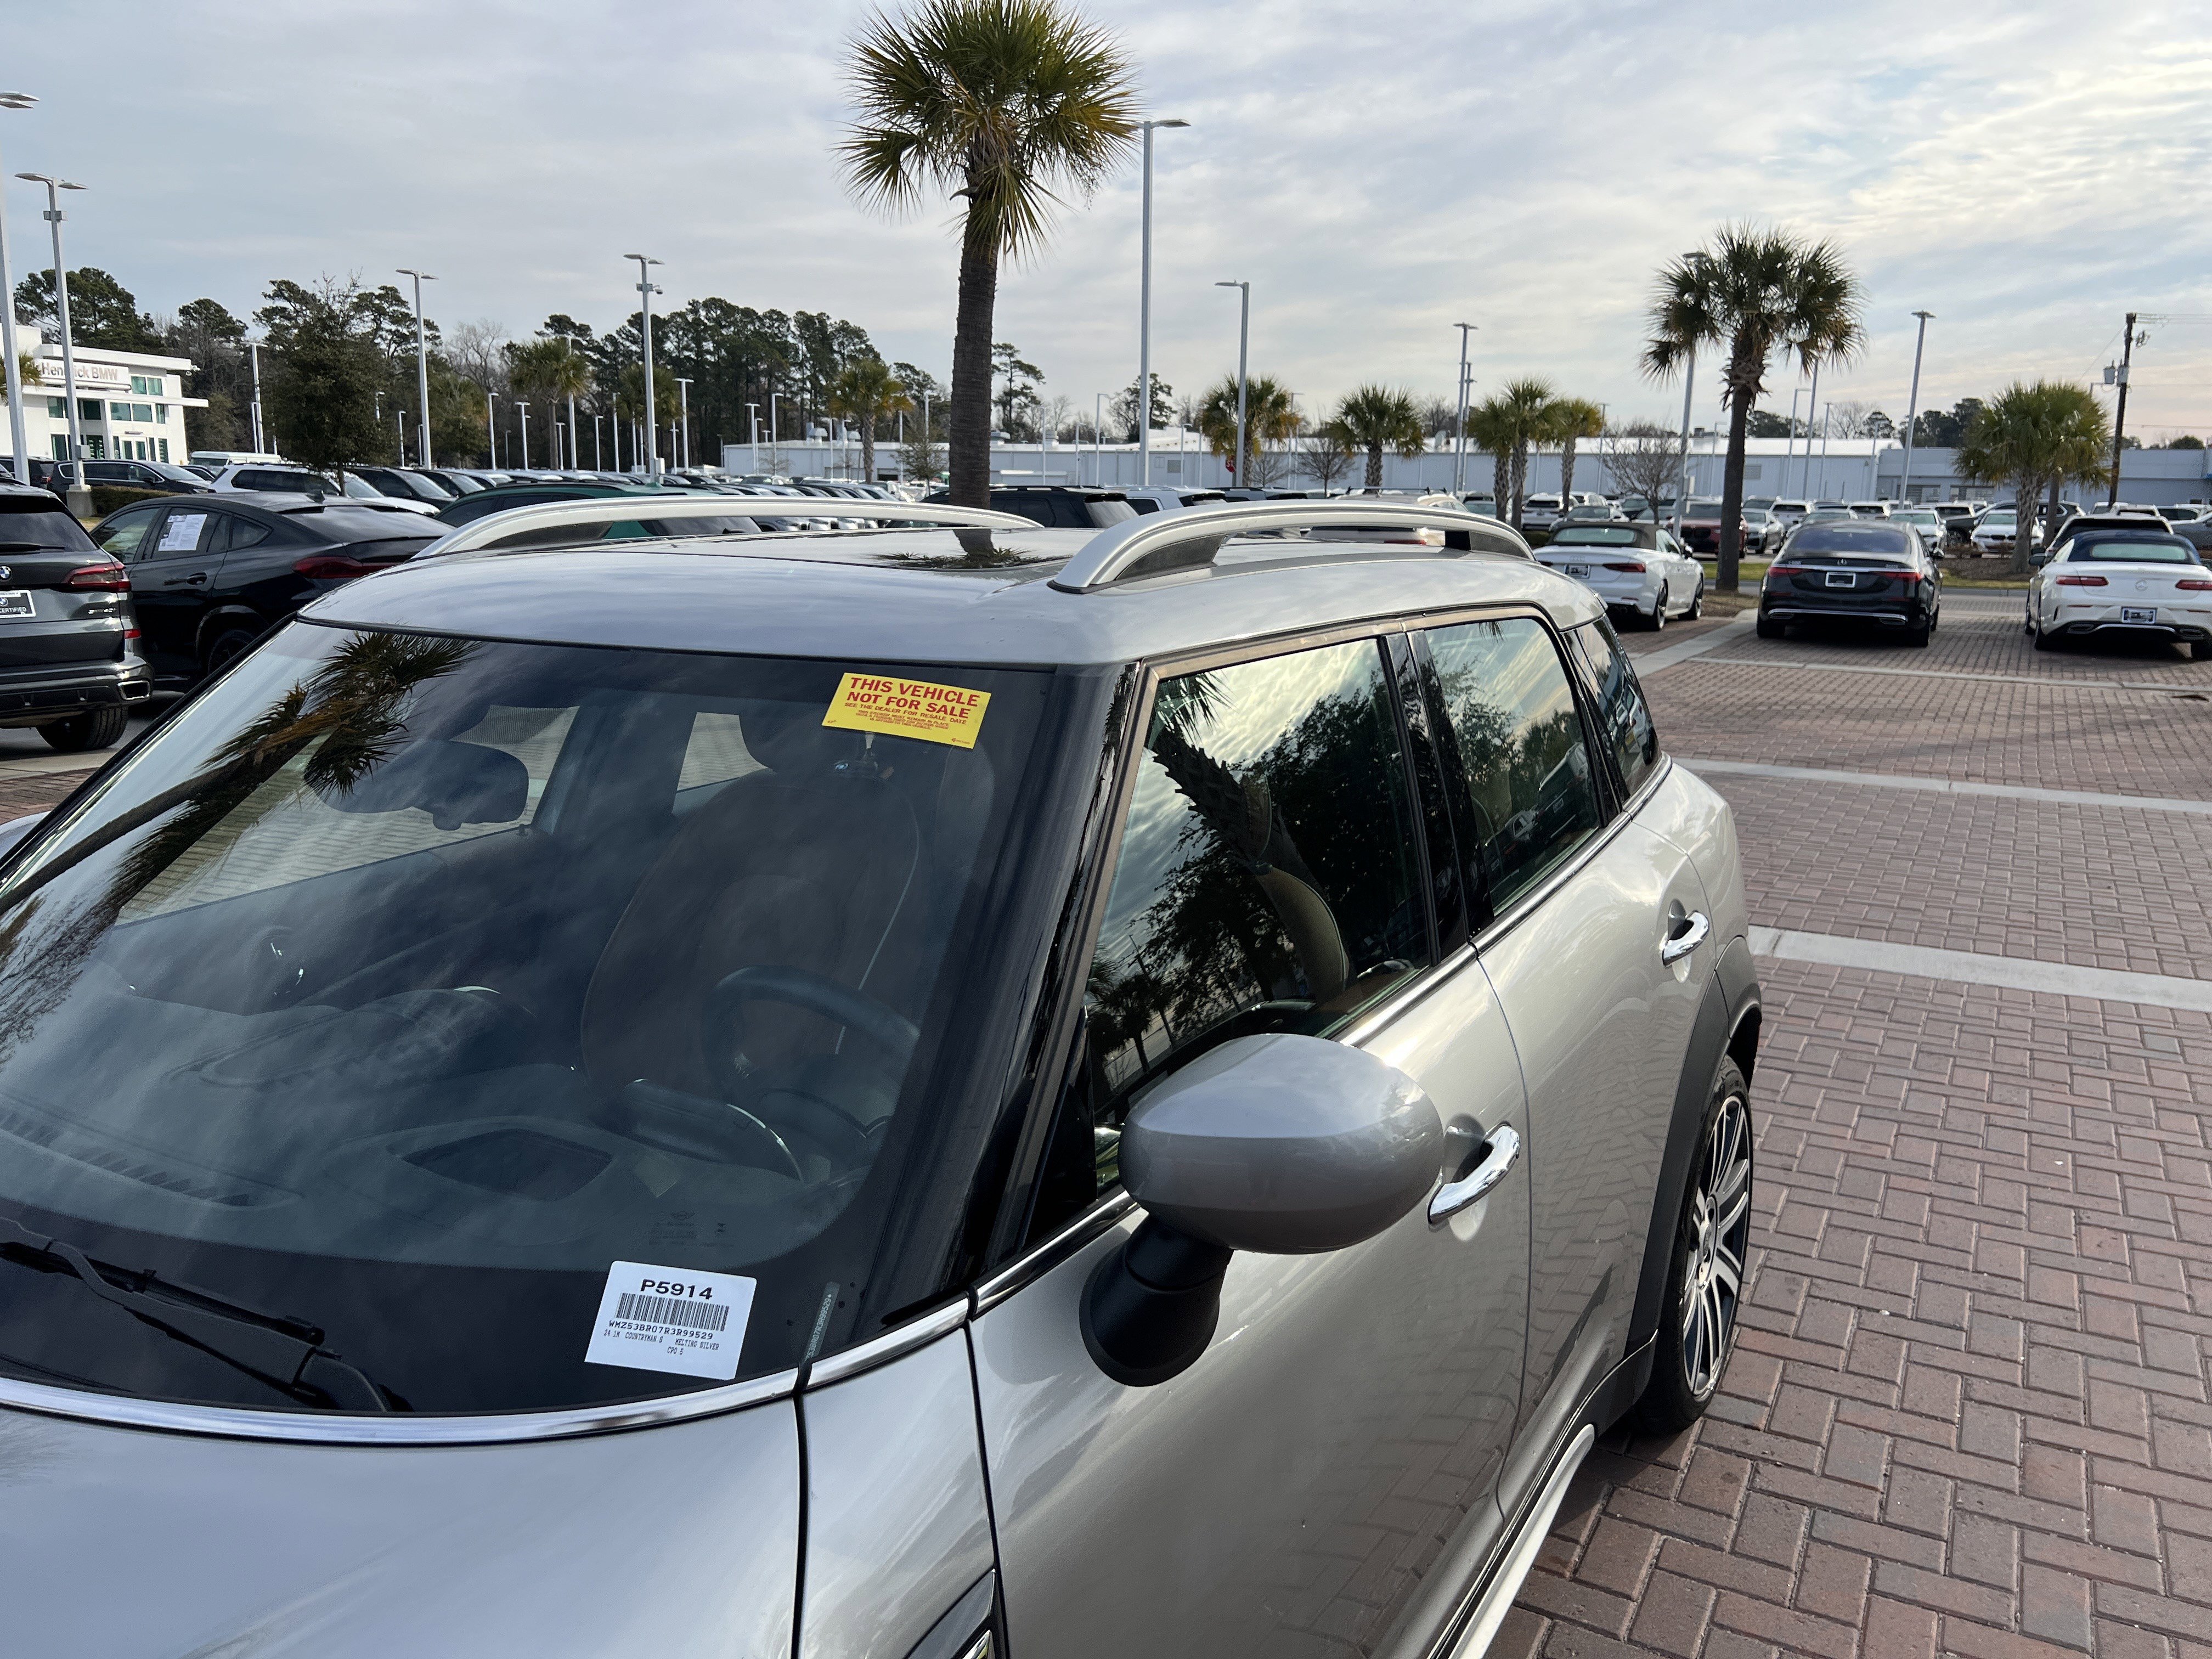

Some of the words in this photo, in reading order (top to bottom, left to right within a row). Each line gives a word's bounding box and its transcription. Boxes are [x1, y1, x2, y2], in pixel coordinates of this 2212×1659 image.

[42, 362, 89, 379] Henick
[92, 366, 117, 381] BMW
[851, 678, 893, 692] THIS
[900, 683, 980, 707] VEHICLE
[847, 691, 882, 704] NOT
[885, 696, 921, 710] FOR
[926, 703, 970, 718] SALE
[920, 713, 946, 721] RESALE
[640, 1279, 713, 1300] P5914
[604, 1329, 611, 1337] 24
[625, 1332, 657, 1342] COUNTRYMAN
[675, 1338, 697, 1347] MELTING
[699, 1342, 720, 1350] SILVER
[608, 1320, 713, 1340] WMZ53BR07R3R99529
[667, 1346, 678, 1355] CPO
